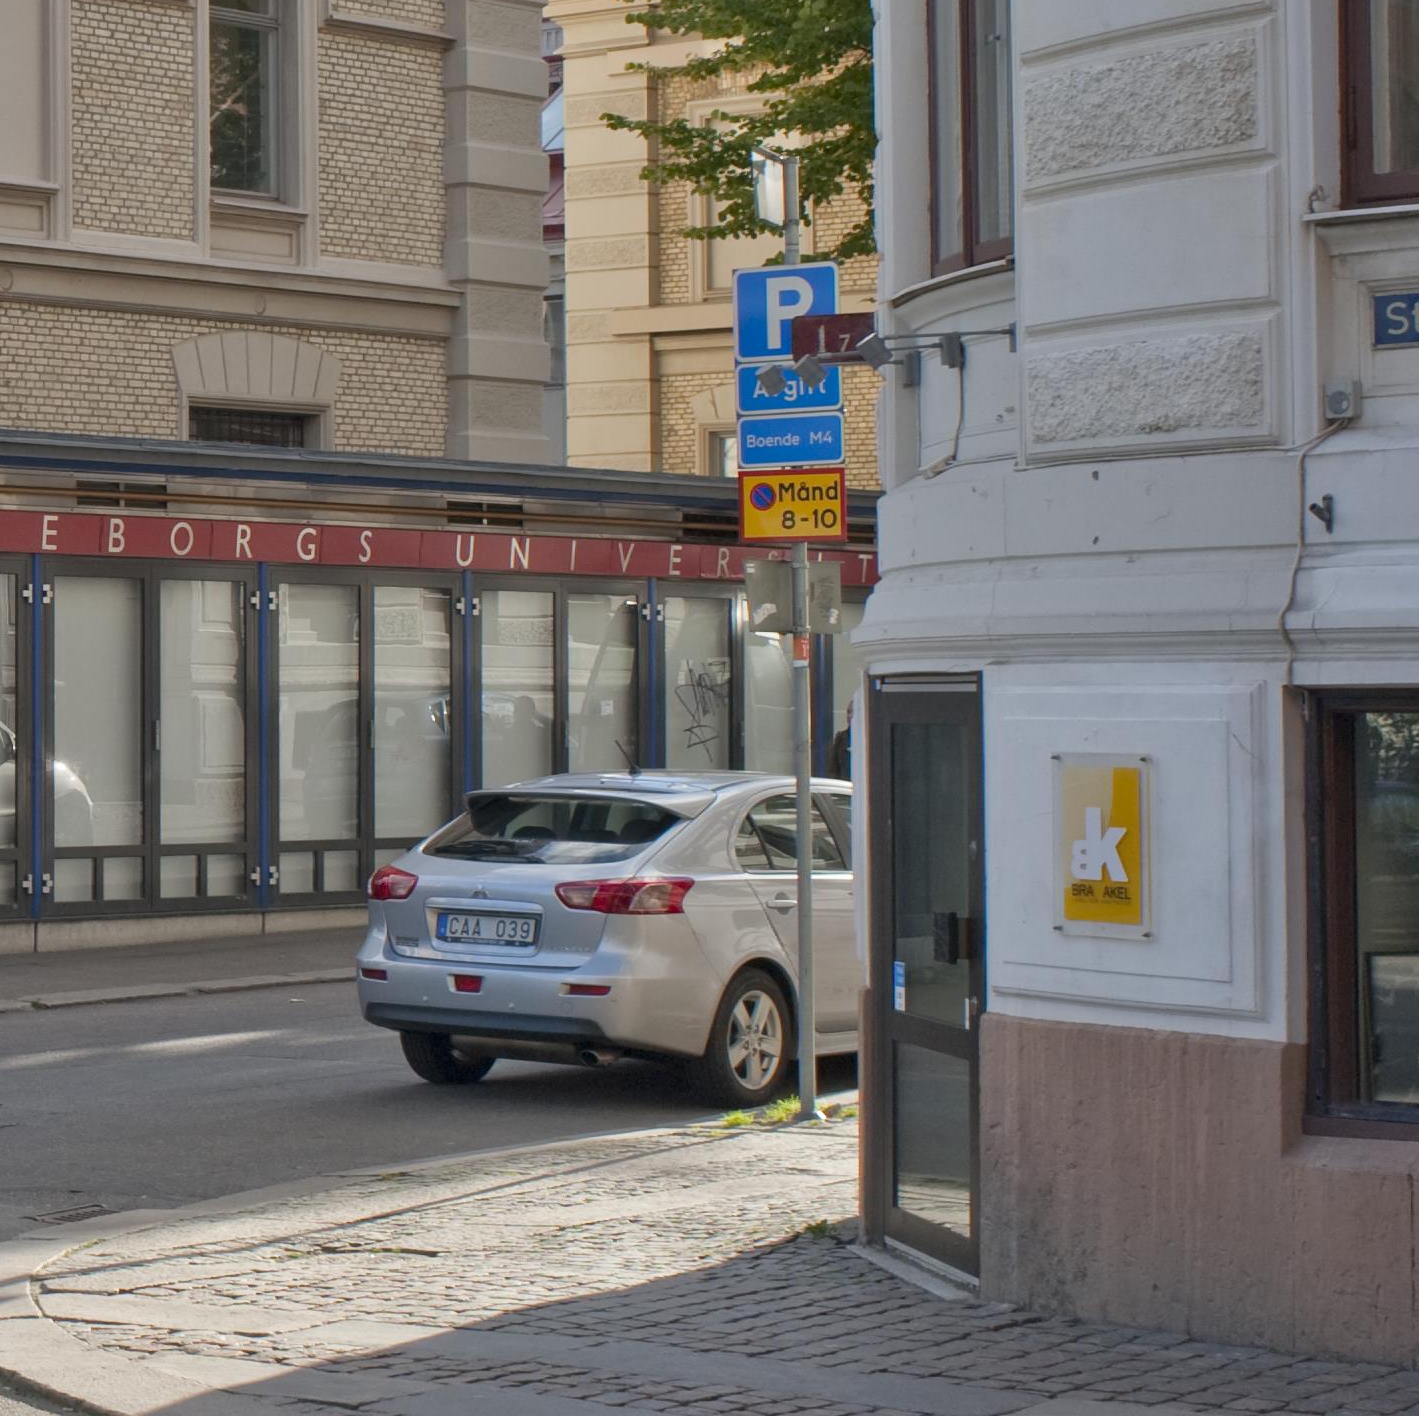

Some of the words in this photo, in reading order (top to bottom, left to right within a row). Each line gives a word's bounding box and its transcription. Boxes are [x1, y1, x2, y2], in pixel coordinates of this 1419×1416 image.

[765, 275, 814, 350] P
[746, 433, 800, 449] Boende
[809, 431, 833, 445] M4
[778, 480, 838, 503] Månd
[782, 508, 837, 530] 8-10
[1071, 883, 1094, 897] BRA
[449, 916, 482, 937] CAA
[495, 919, 531, 940] 039
